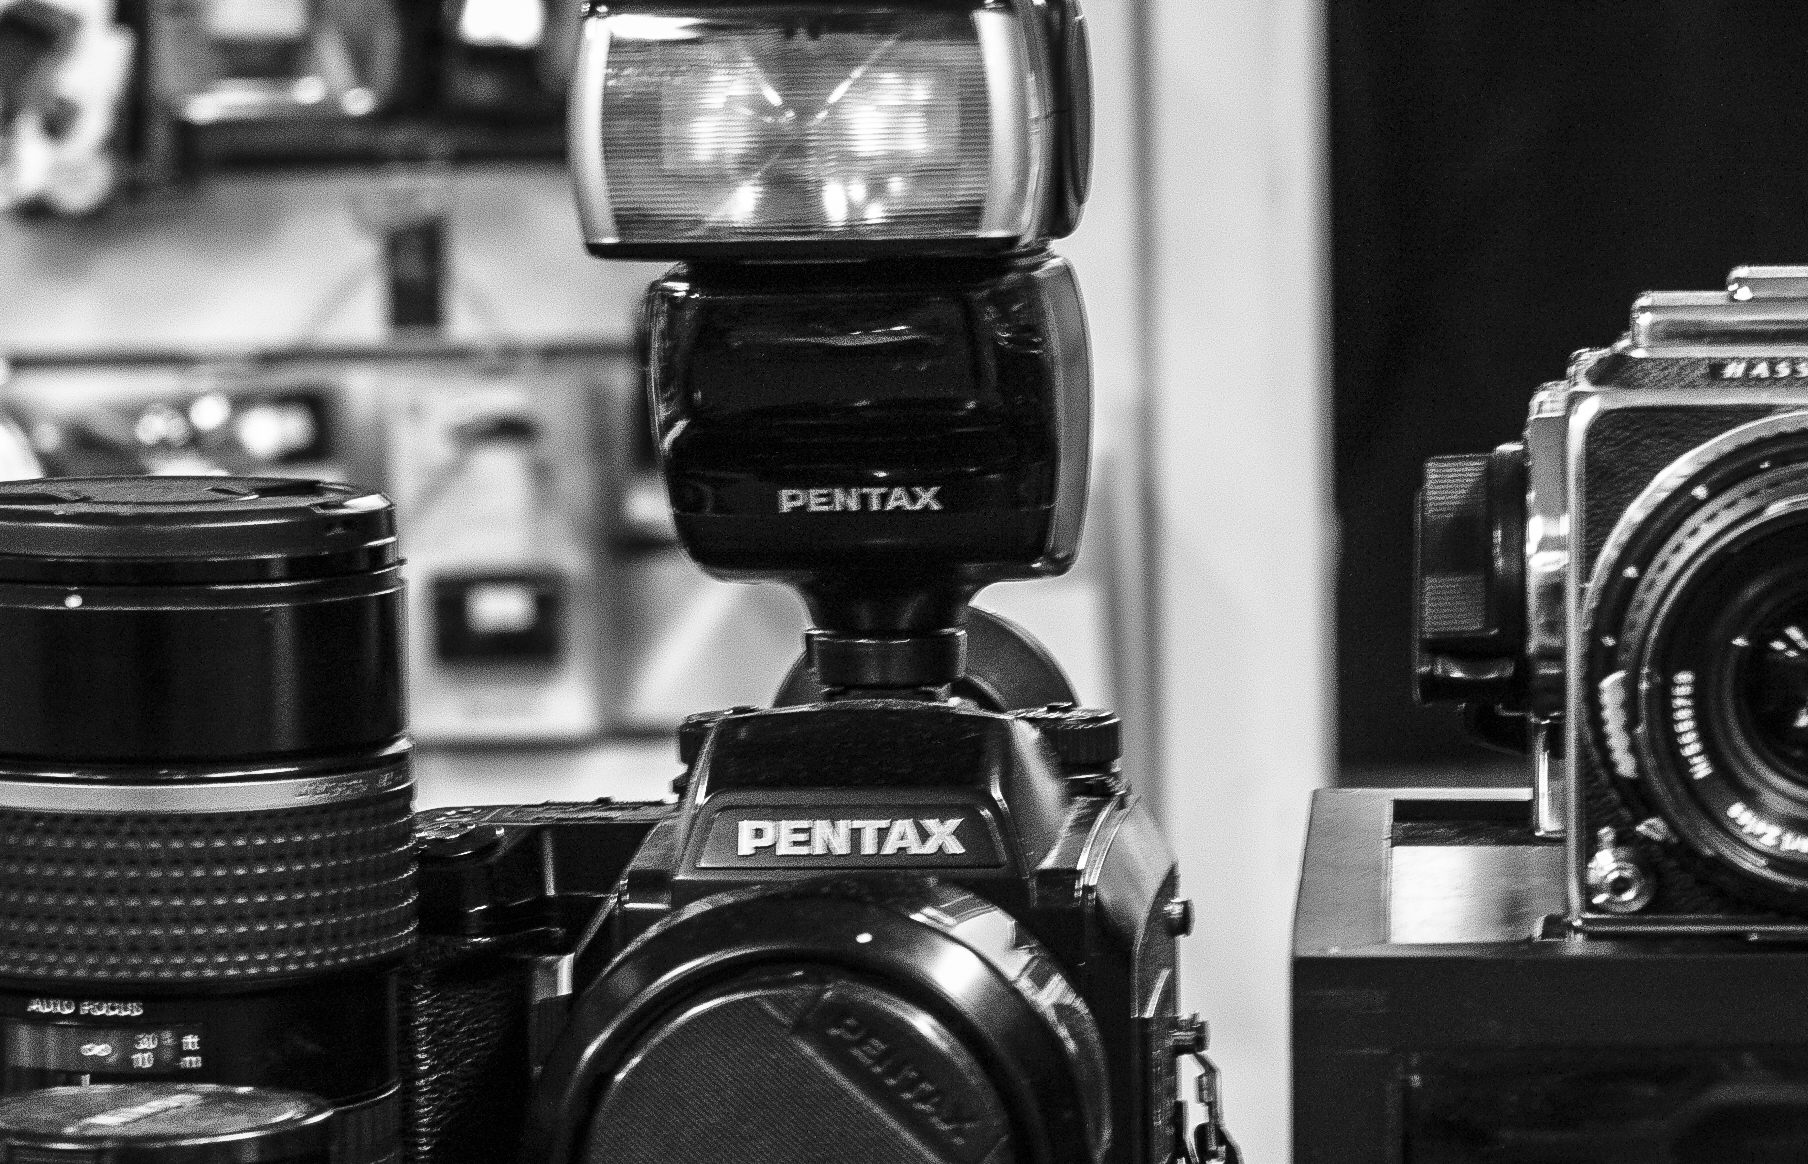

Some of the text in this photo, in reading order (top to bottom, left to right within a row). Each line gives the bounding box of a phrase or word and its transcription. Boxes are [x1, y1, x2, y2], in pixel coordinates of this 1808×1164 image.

[777, 486, 943, 514] PENTAX
[737, 818, 967, 856] PENTAX
[26, 997, 145, 1018] AUTO FOCUS
[824, 1013, 986, 1144] PENTAX
